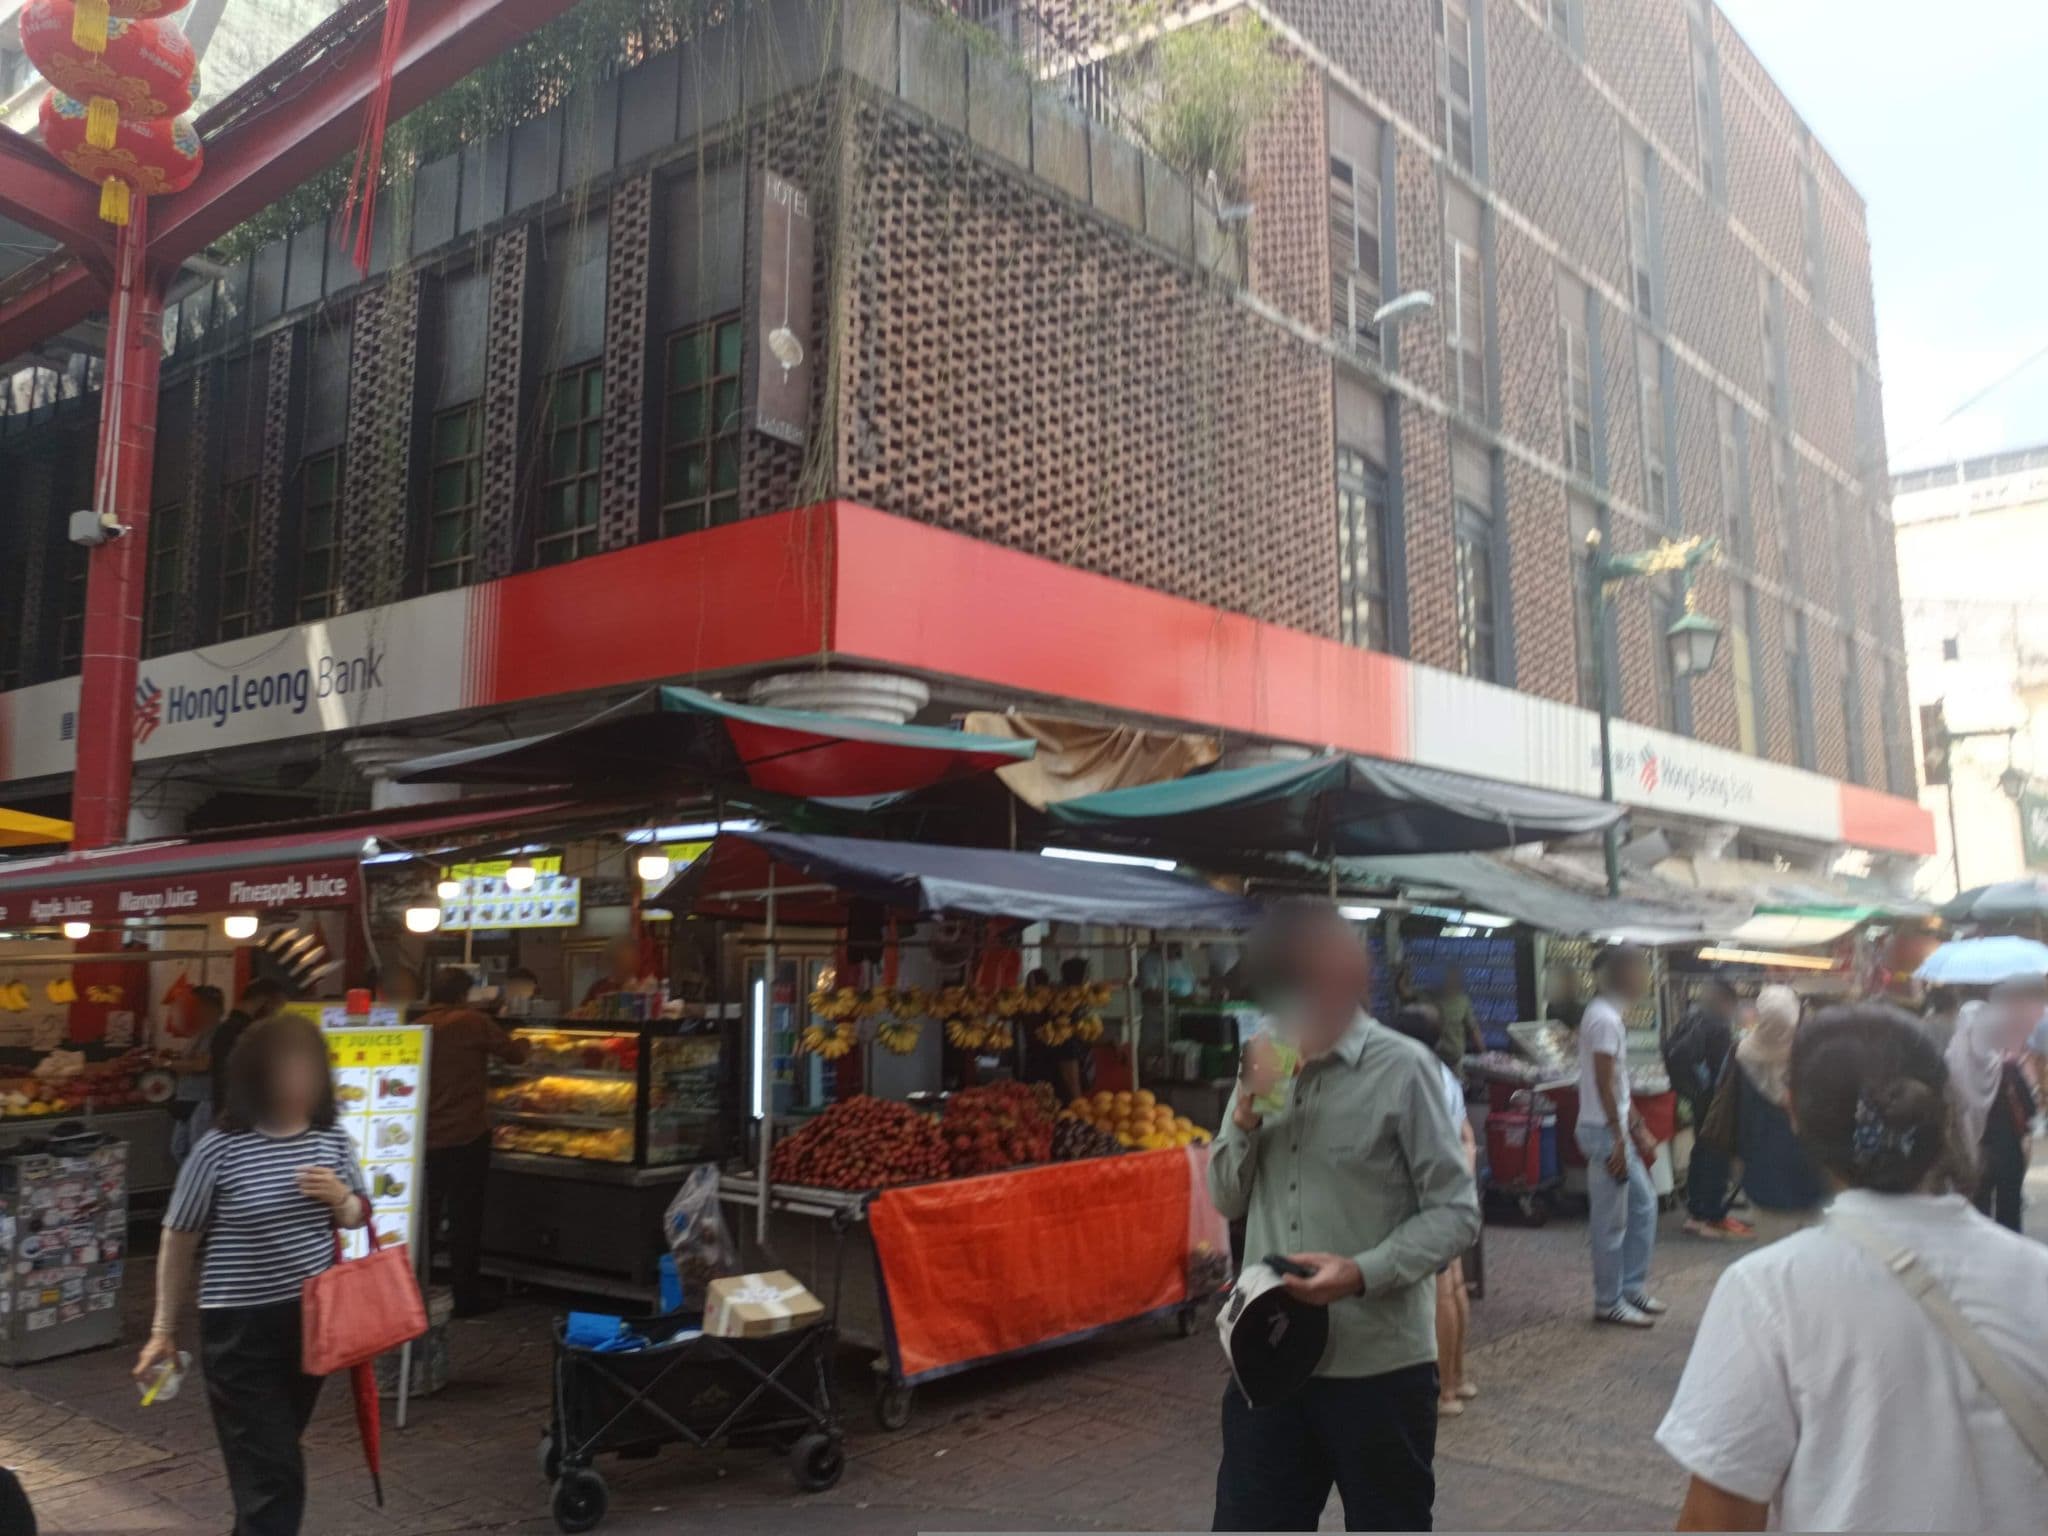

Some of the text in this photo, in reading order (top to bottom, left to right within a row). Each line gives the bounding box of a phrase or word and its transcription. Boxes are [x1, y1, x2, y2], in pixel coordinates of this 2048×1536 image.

[766, 175, 809, 217] HOTEL
[167, 648, 383, 728] HongLeong Bank
[64, 896, 95, 915] Juice
[118, 886, 199, 915] Mango Juice
[229, 873, 348, 907] Pineapple Juice
[348, 1033, 403, 1047] JUICES
